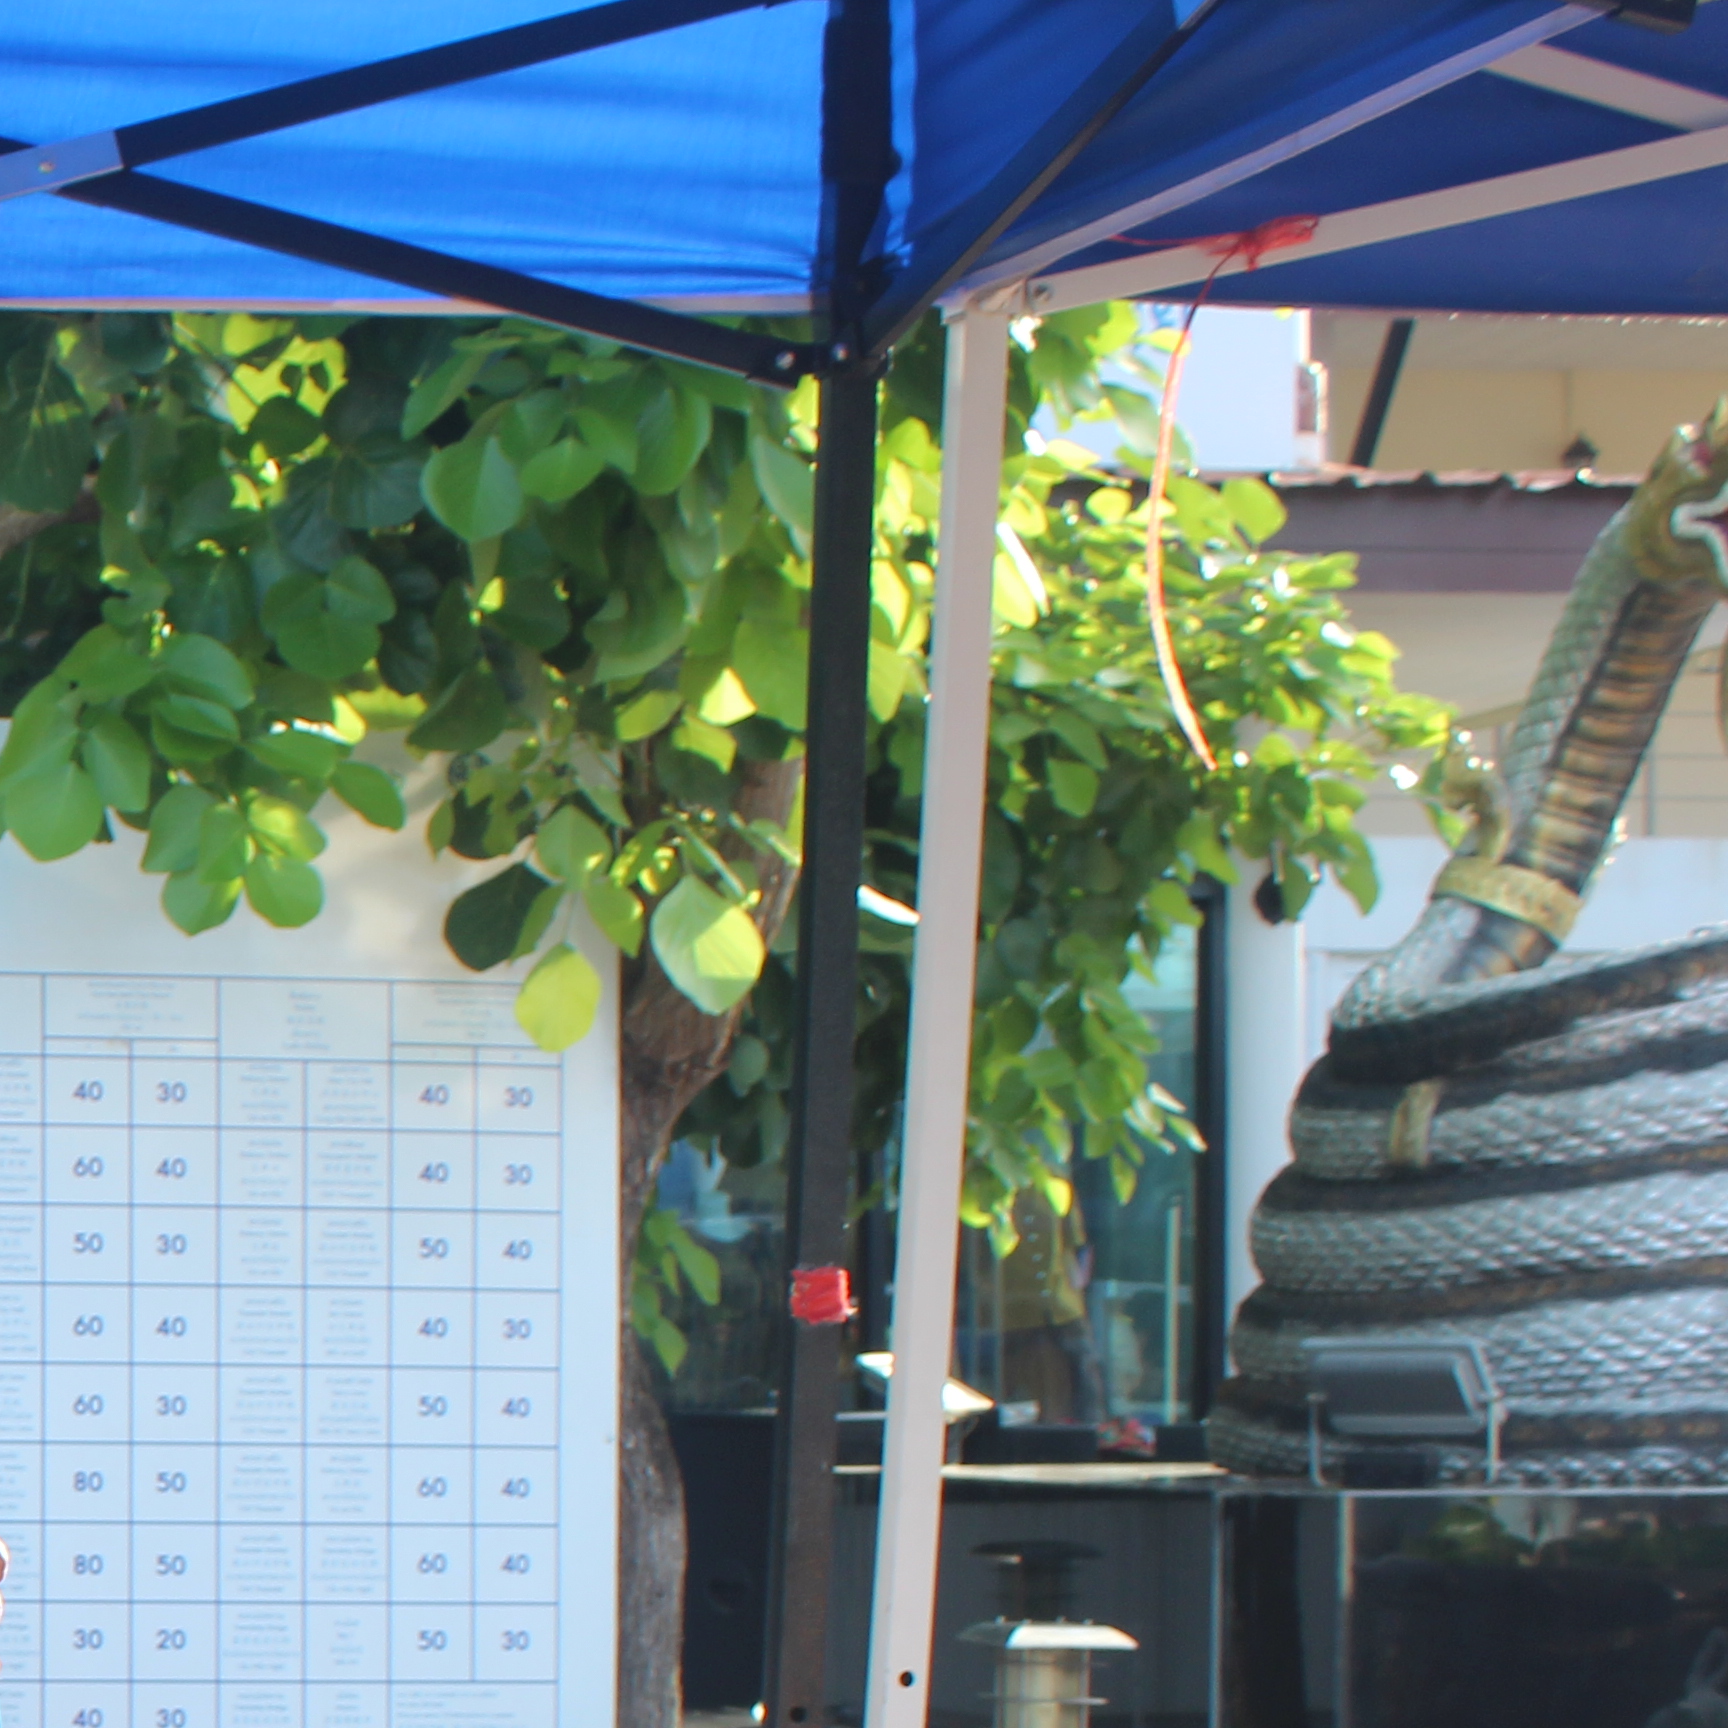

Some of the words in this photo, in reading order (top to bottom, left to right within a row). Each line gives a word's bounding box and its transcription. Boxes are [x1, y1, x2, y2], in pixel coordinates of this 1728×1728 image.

[72, 1079, 104, 1102] 40
[156, 1080, 188, 1104] 30
[418, 1083, 450, 1106] 40
[504, 1085, 535, 1109] 30
[71, 1155, 105, 1179] 60
[155, 1156, 188, 1180] 40
[418, 1161, 450, 1184] 40
[504, 1163, 534, 1187] 30
[72, 1231, 105, 1255] 50
[156, 1232, 188, 1256] 30
[418, 1236, 450, 1260] 50
[502, 1238, 533, 1261] 40
[72, 1314, 105, 1338] 60
[155, 1315, 187, 1338] 40
[417, 1316, 449, 1339] 40
[502, 1317, 533, 1341] 30
[72, 1393, 105, 1417] 60
[156, 1394, 188, 1417] 30
[418, 1394, 449, 1418] 50
[500, 1396, 531, 1419] 40
[72, 1470, 105, 1493] 80
[156, 1470, 188, 1494] 50
[416, 1475, 448, 1499] 60
[500, 1476, 531, 1499] 40
[72, 1553, 105, 1576] 80
[156, 1553, 188, 1577] 50
[416, 1552, 448, 1575] 60
[500, 1553, 531, 1576] 40
[72, 1627, 104, 1651] 30
[155, 1628, 188, 1651] 20
[417, 1629, 448, 1652] 50
[501, 1629, 531, 1652] 30
